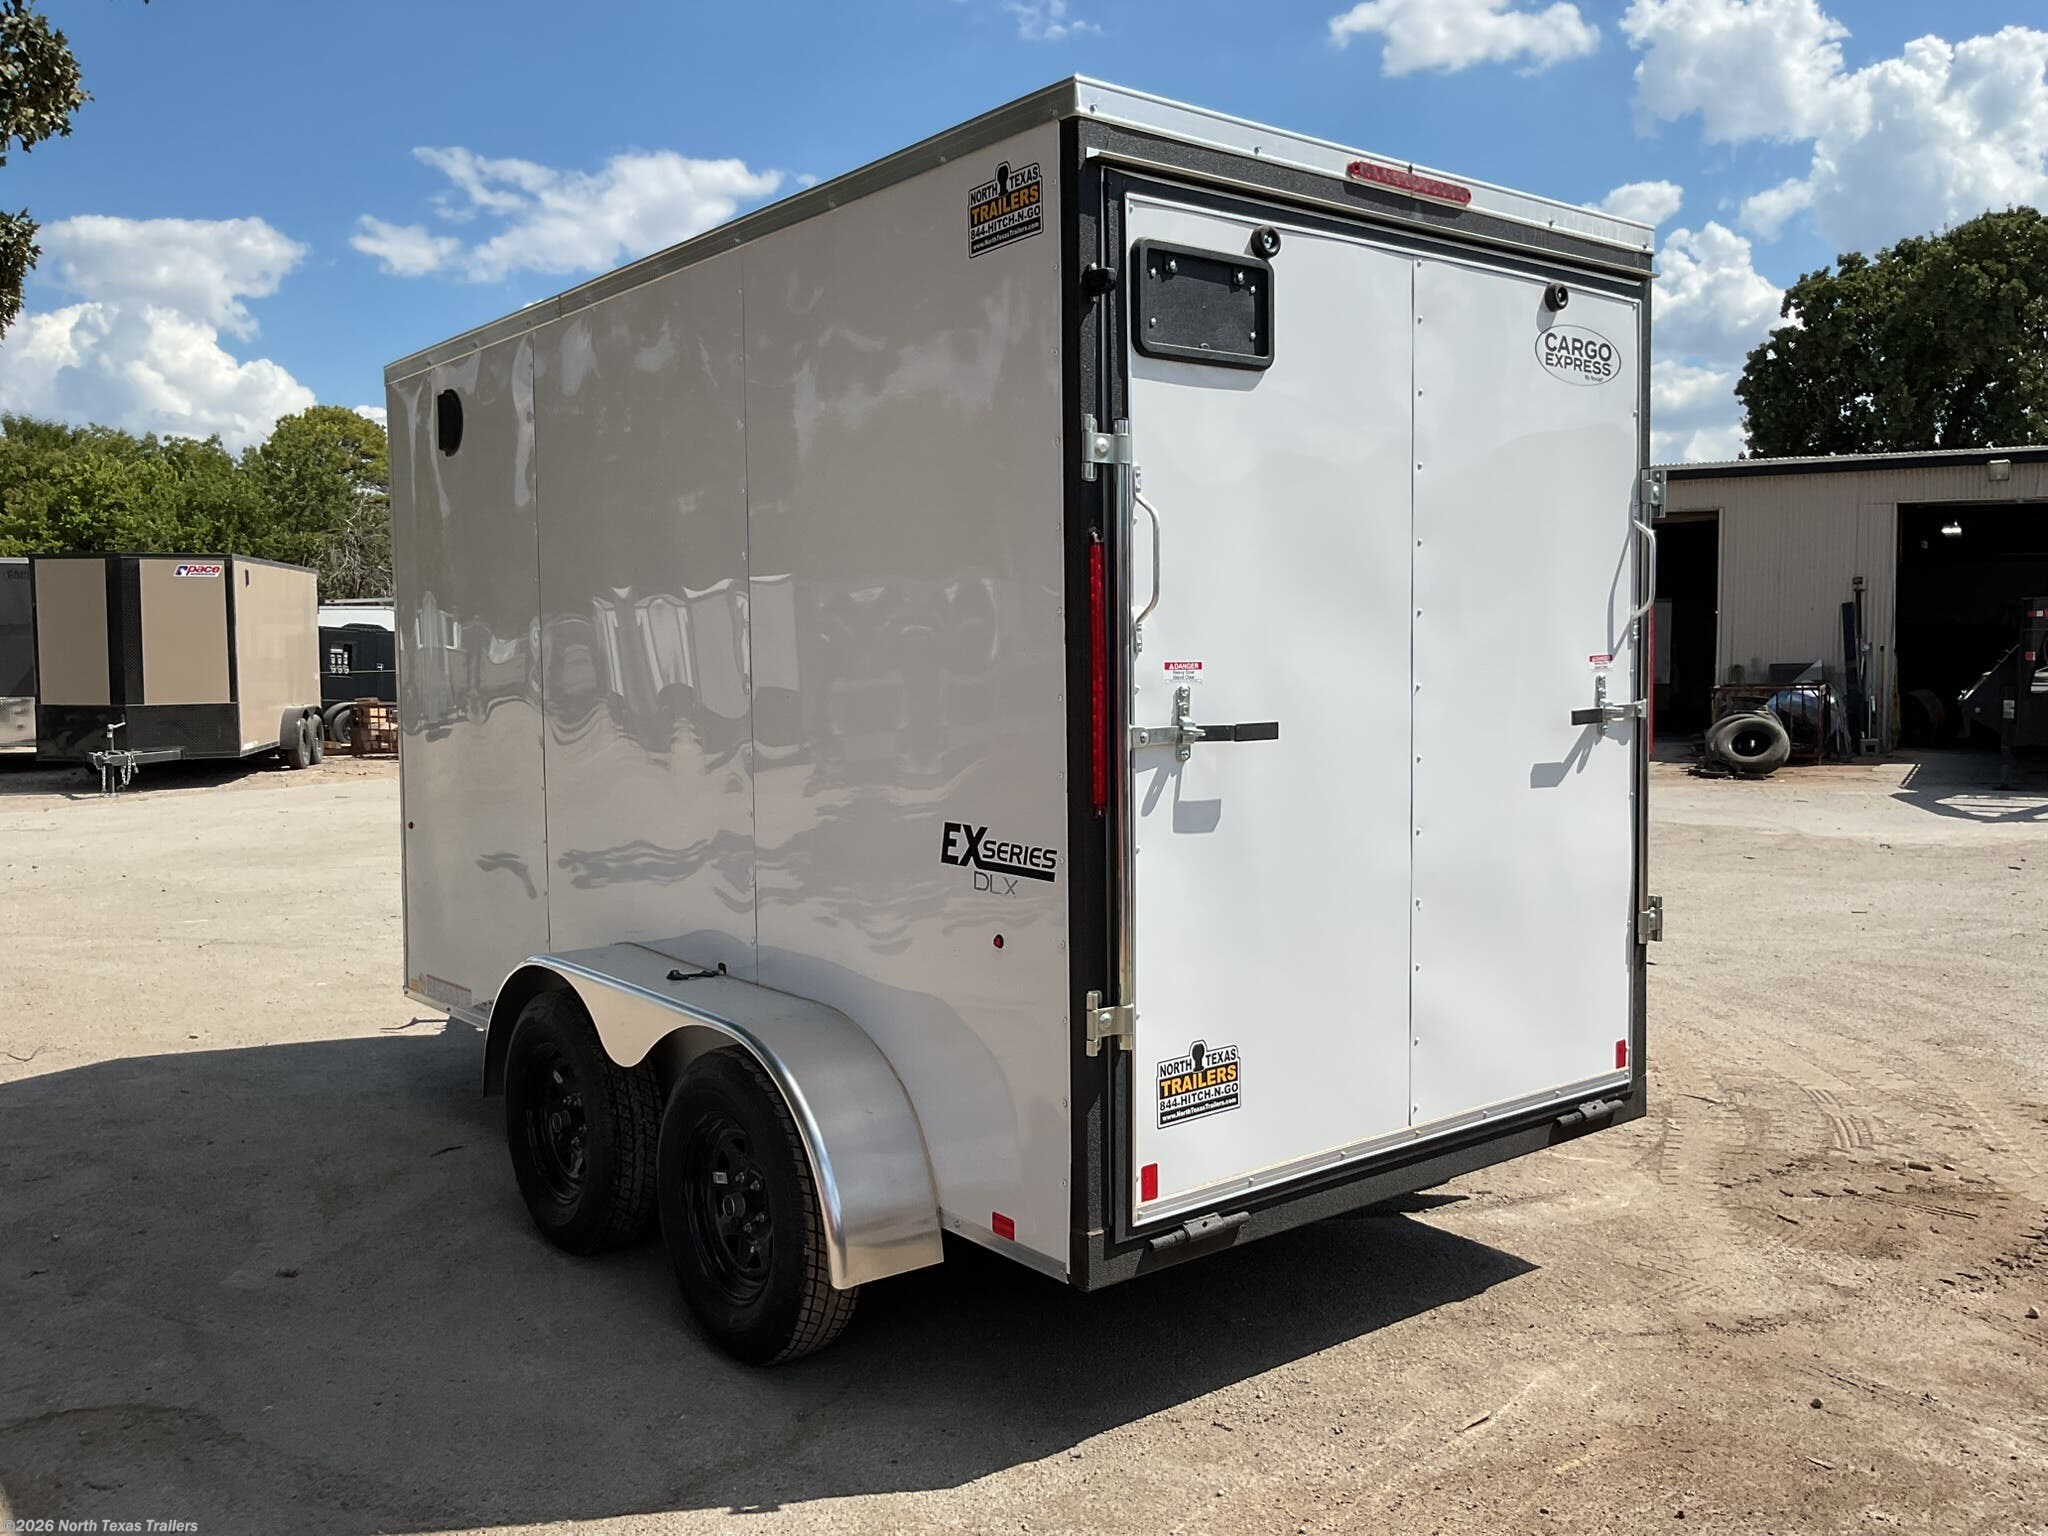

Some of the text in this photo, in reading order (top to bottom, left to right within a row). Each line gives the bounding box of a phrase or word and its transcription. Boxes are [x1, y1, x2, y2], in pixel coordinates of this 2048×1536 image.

[970, 166, 1038, 206] NORTH TEXAS
[971, 184, 1039, 225] TRAILERS
[1544, 332, 1612, 362] CARGO
[1545, 352, 1612, 377] EXPRESS
[1174, 662, 1199, 670] DANGER
[973, 870, 1019, 896] DLX
[1160, 1048, 1237, 1078] NORTH TEXAS
[1160, 1064, 1237, 1097] TRAILERS
[1161, 1097, 1238, 1122] www.NorthTexasTrailers.com
